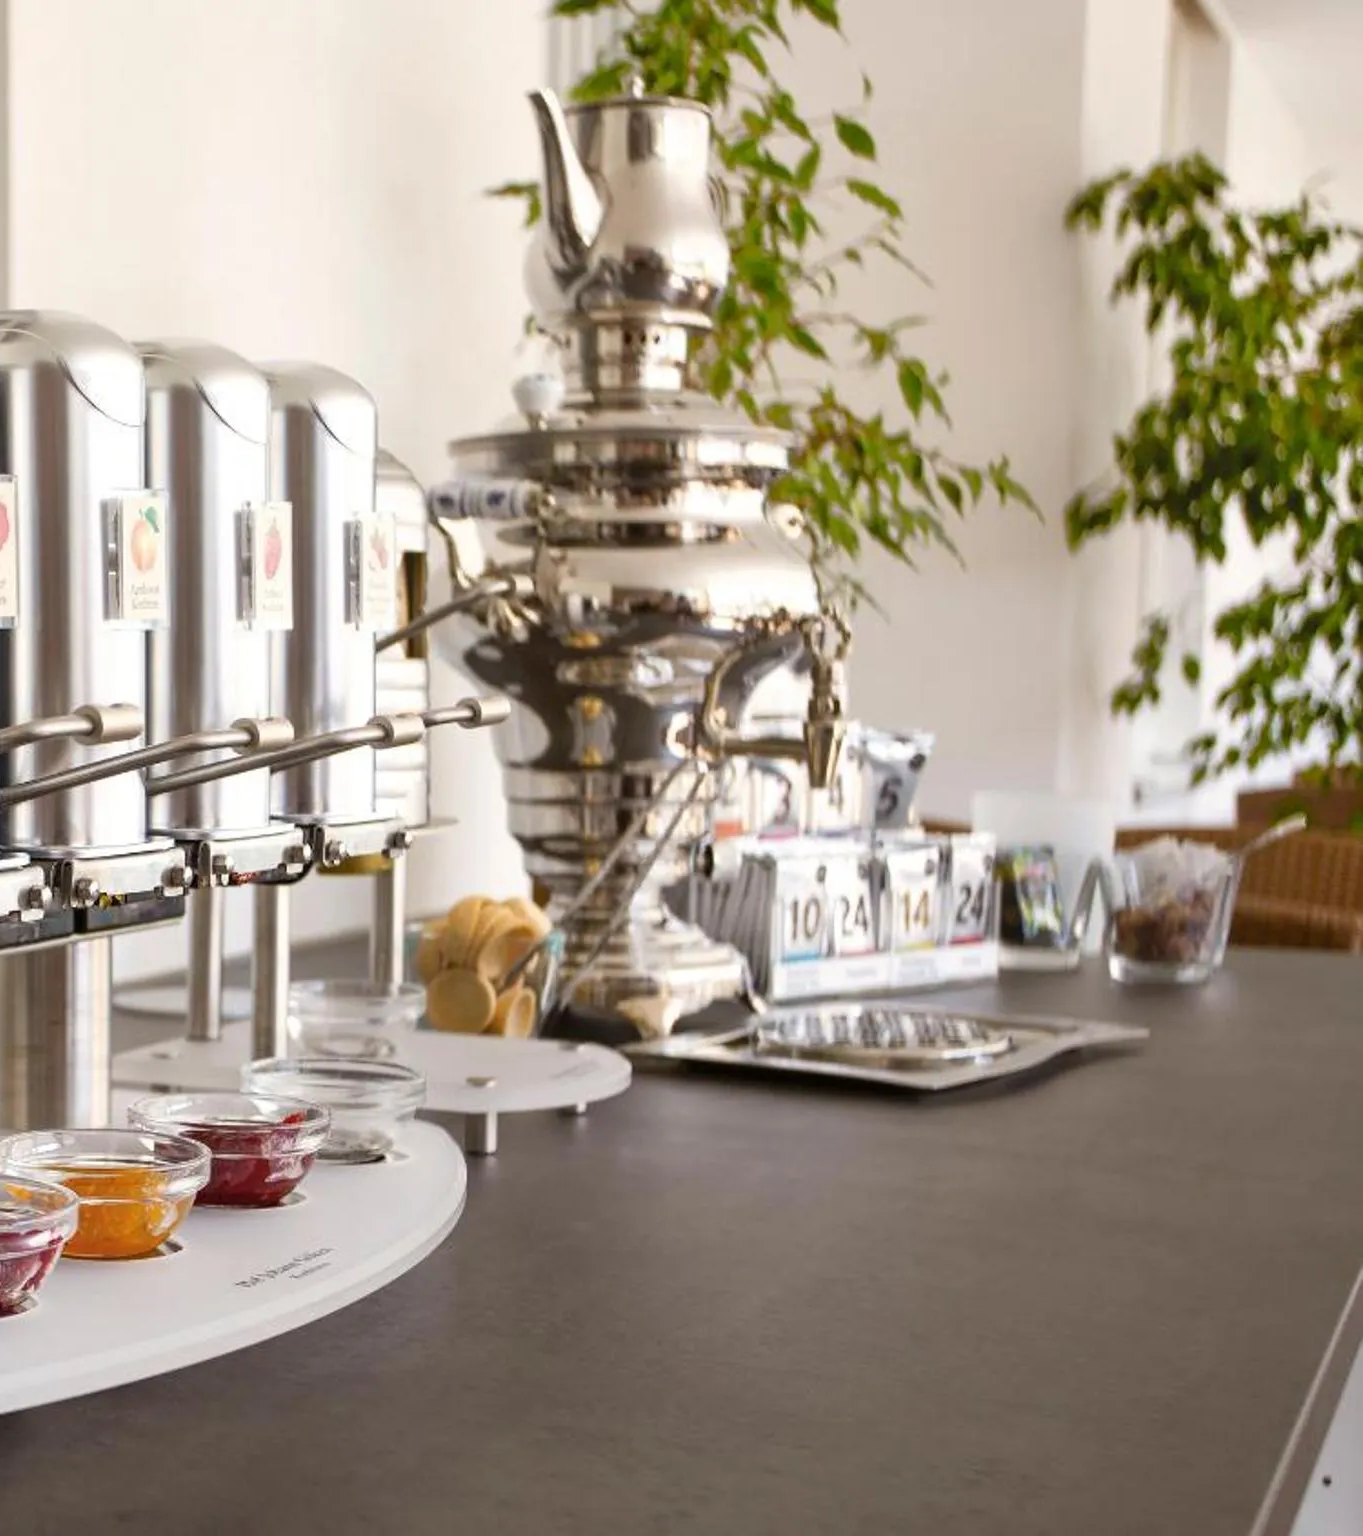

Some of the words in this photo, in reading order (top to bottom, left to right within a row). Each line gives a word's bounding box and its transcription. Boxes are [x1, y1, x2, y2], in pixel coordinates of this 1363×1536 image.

[791, 897, 821, 941] 10
[840, 894, 869, 938] 24
[902, 889, 930, 930] 14
[955, 884, 985, 926] 24
